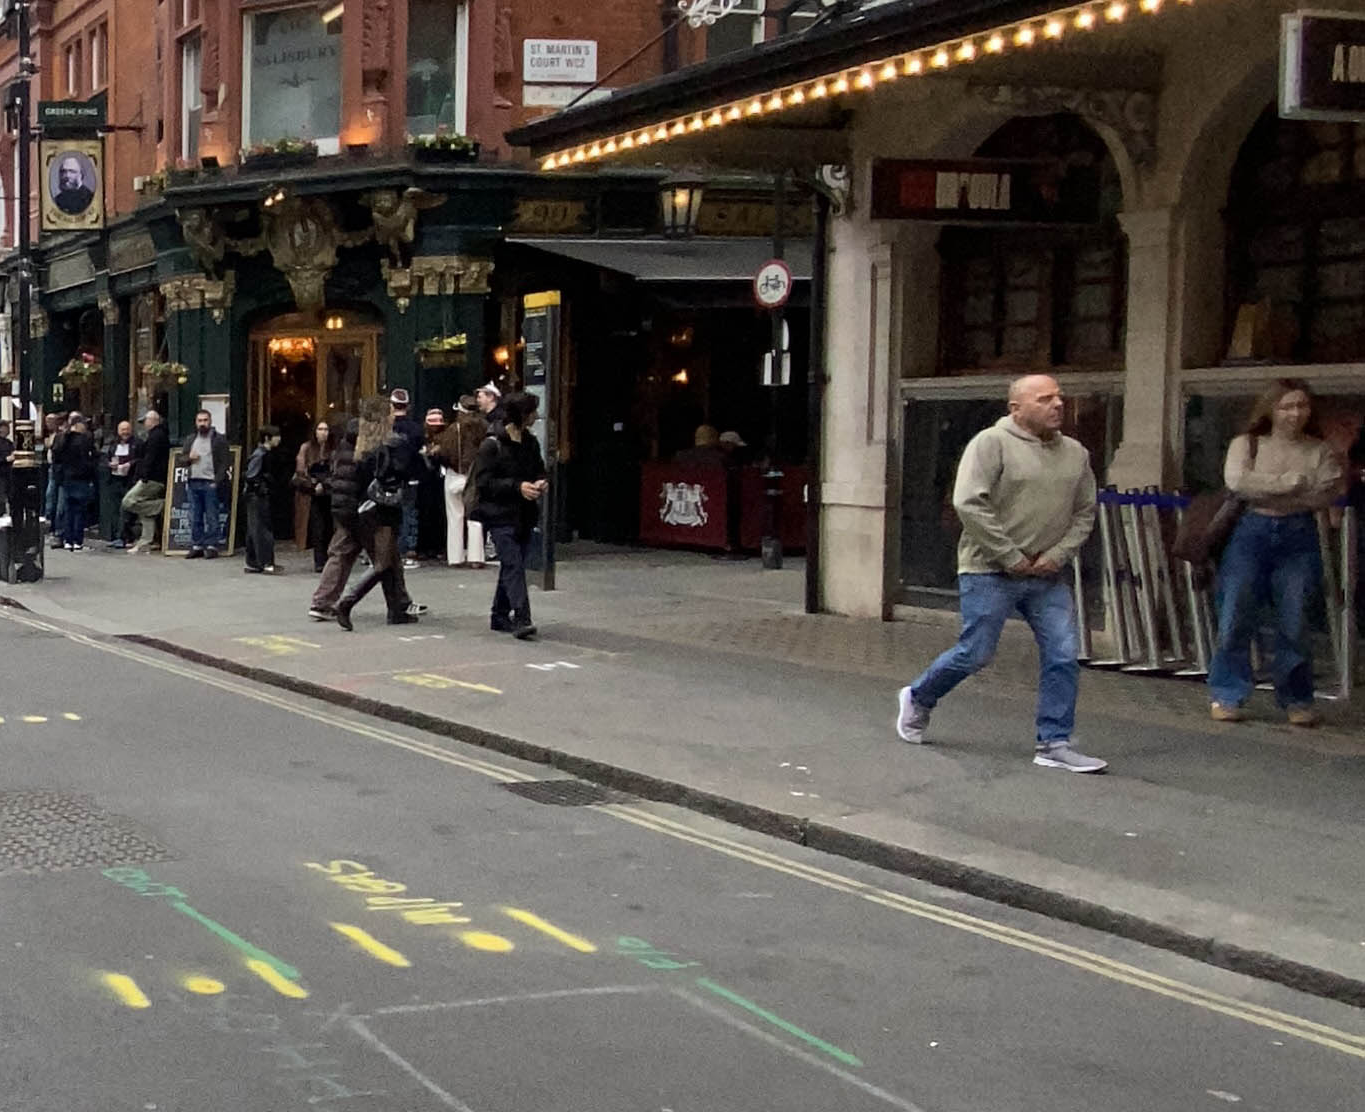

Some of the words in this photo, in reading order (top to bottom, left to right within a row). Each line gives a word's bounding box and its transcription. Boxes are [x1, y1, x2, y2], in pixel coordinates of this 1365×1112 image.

[546, 44, 591, 55] MARTIN'S
[529, 57, 561, 68] COURT
[565, 57, 586, 69] WC2
[44, 107, 76, 116] GREENE
[77, 107, 98, 116] KING
